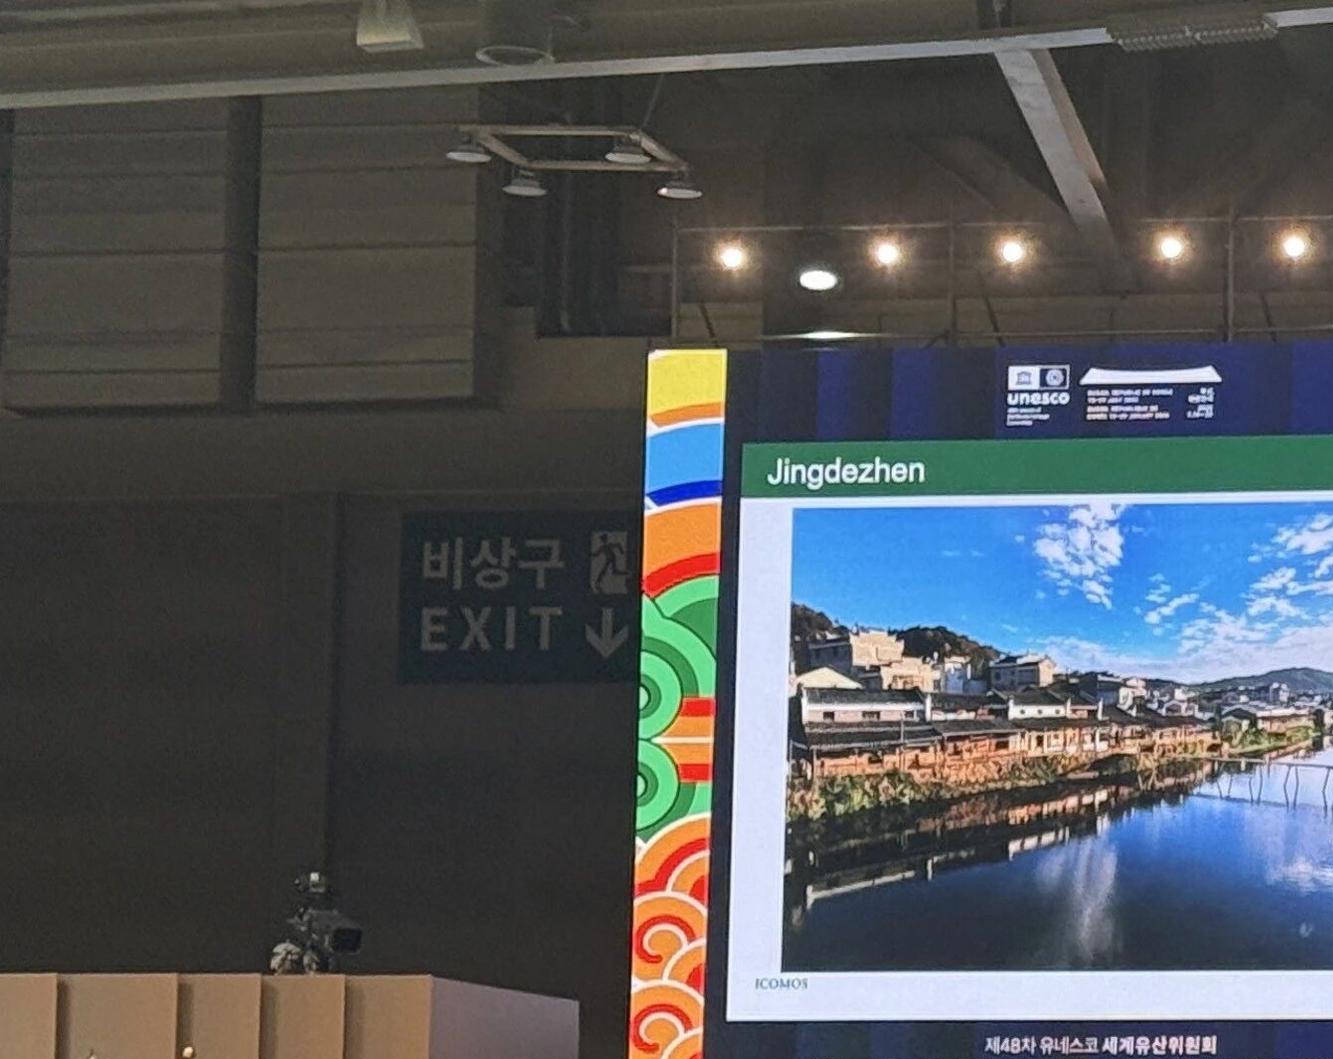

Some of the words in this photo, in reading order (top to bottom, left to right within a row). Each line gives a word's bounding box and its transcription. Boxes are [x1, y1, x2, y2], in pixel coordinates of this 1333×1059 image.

[1006, 391, 1070, 406] unesco
[767, 456, 926, 491] Jingdezhen
[422, 536, 566, 591] 비상구
[420, 606, 563, 651] EXIT
[755, 977, 809, 991] ICOMOS
[984, 1036, 1036, 1055] 제48차
[1040, 1036, 1098, 1055] 유네스코
[1102, 1035, 1217, 1055] 세계유산위원회
